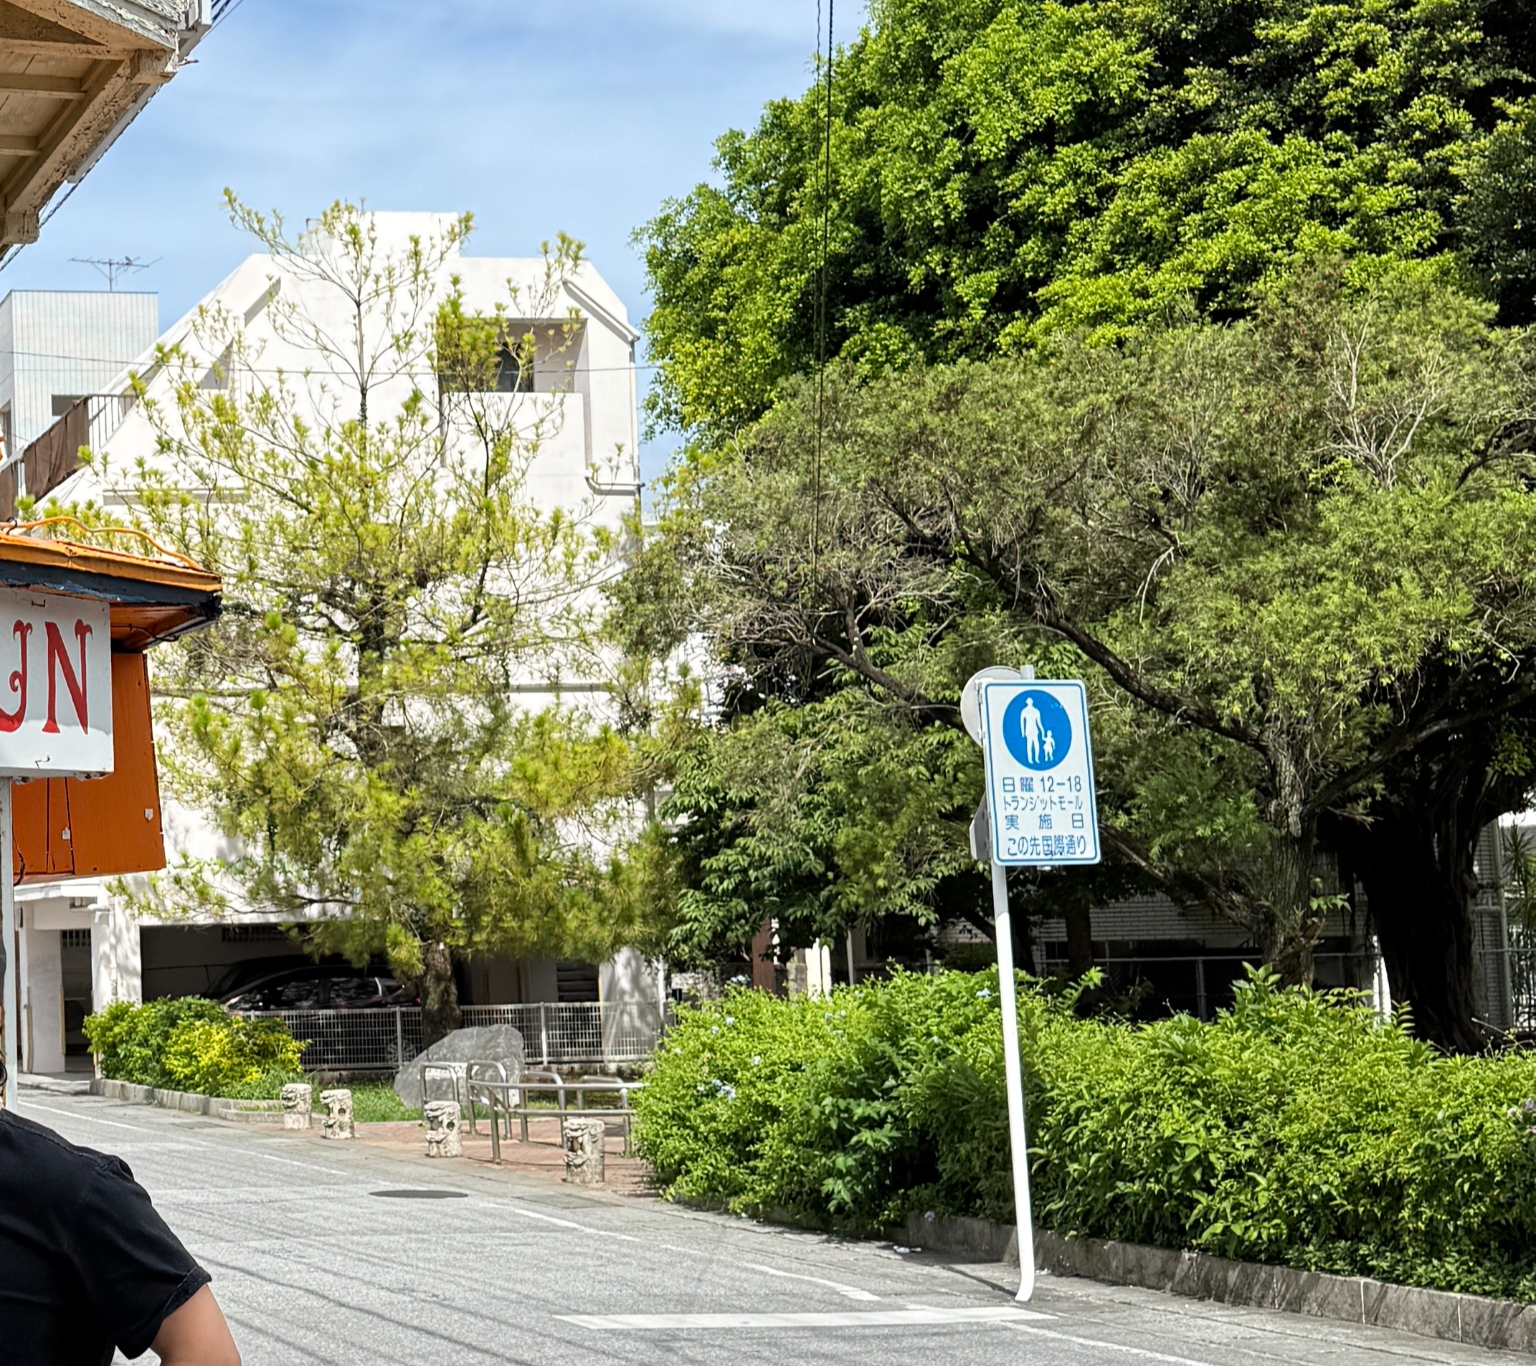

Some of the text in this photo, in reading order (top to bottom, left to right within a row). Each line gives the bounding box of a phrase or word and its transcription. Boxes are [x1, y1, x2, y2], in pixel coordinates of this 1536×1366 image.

[1002, 776, 1034, 793] 日曜
[1003, 795, 1083, 811] トランジットモール
[1007, 834, 1086, 856] この先国際通り
